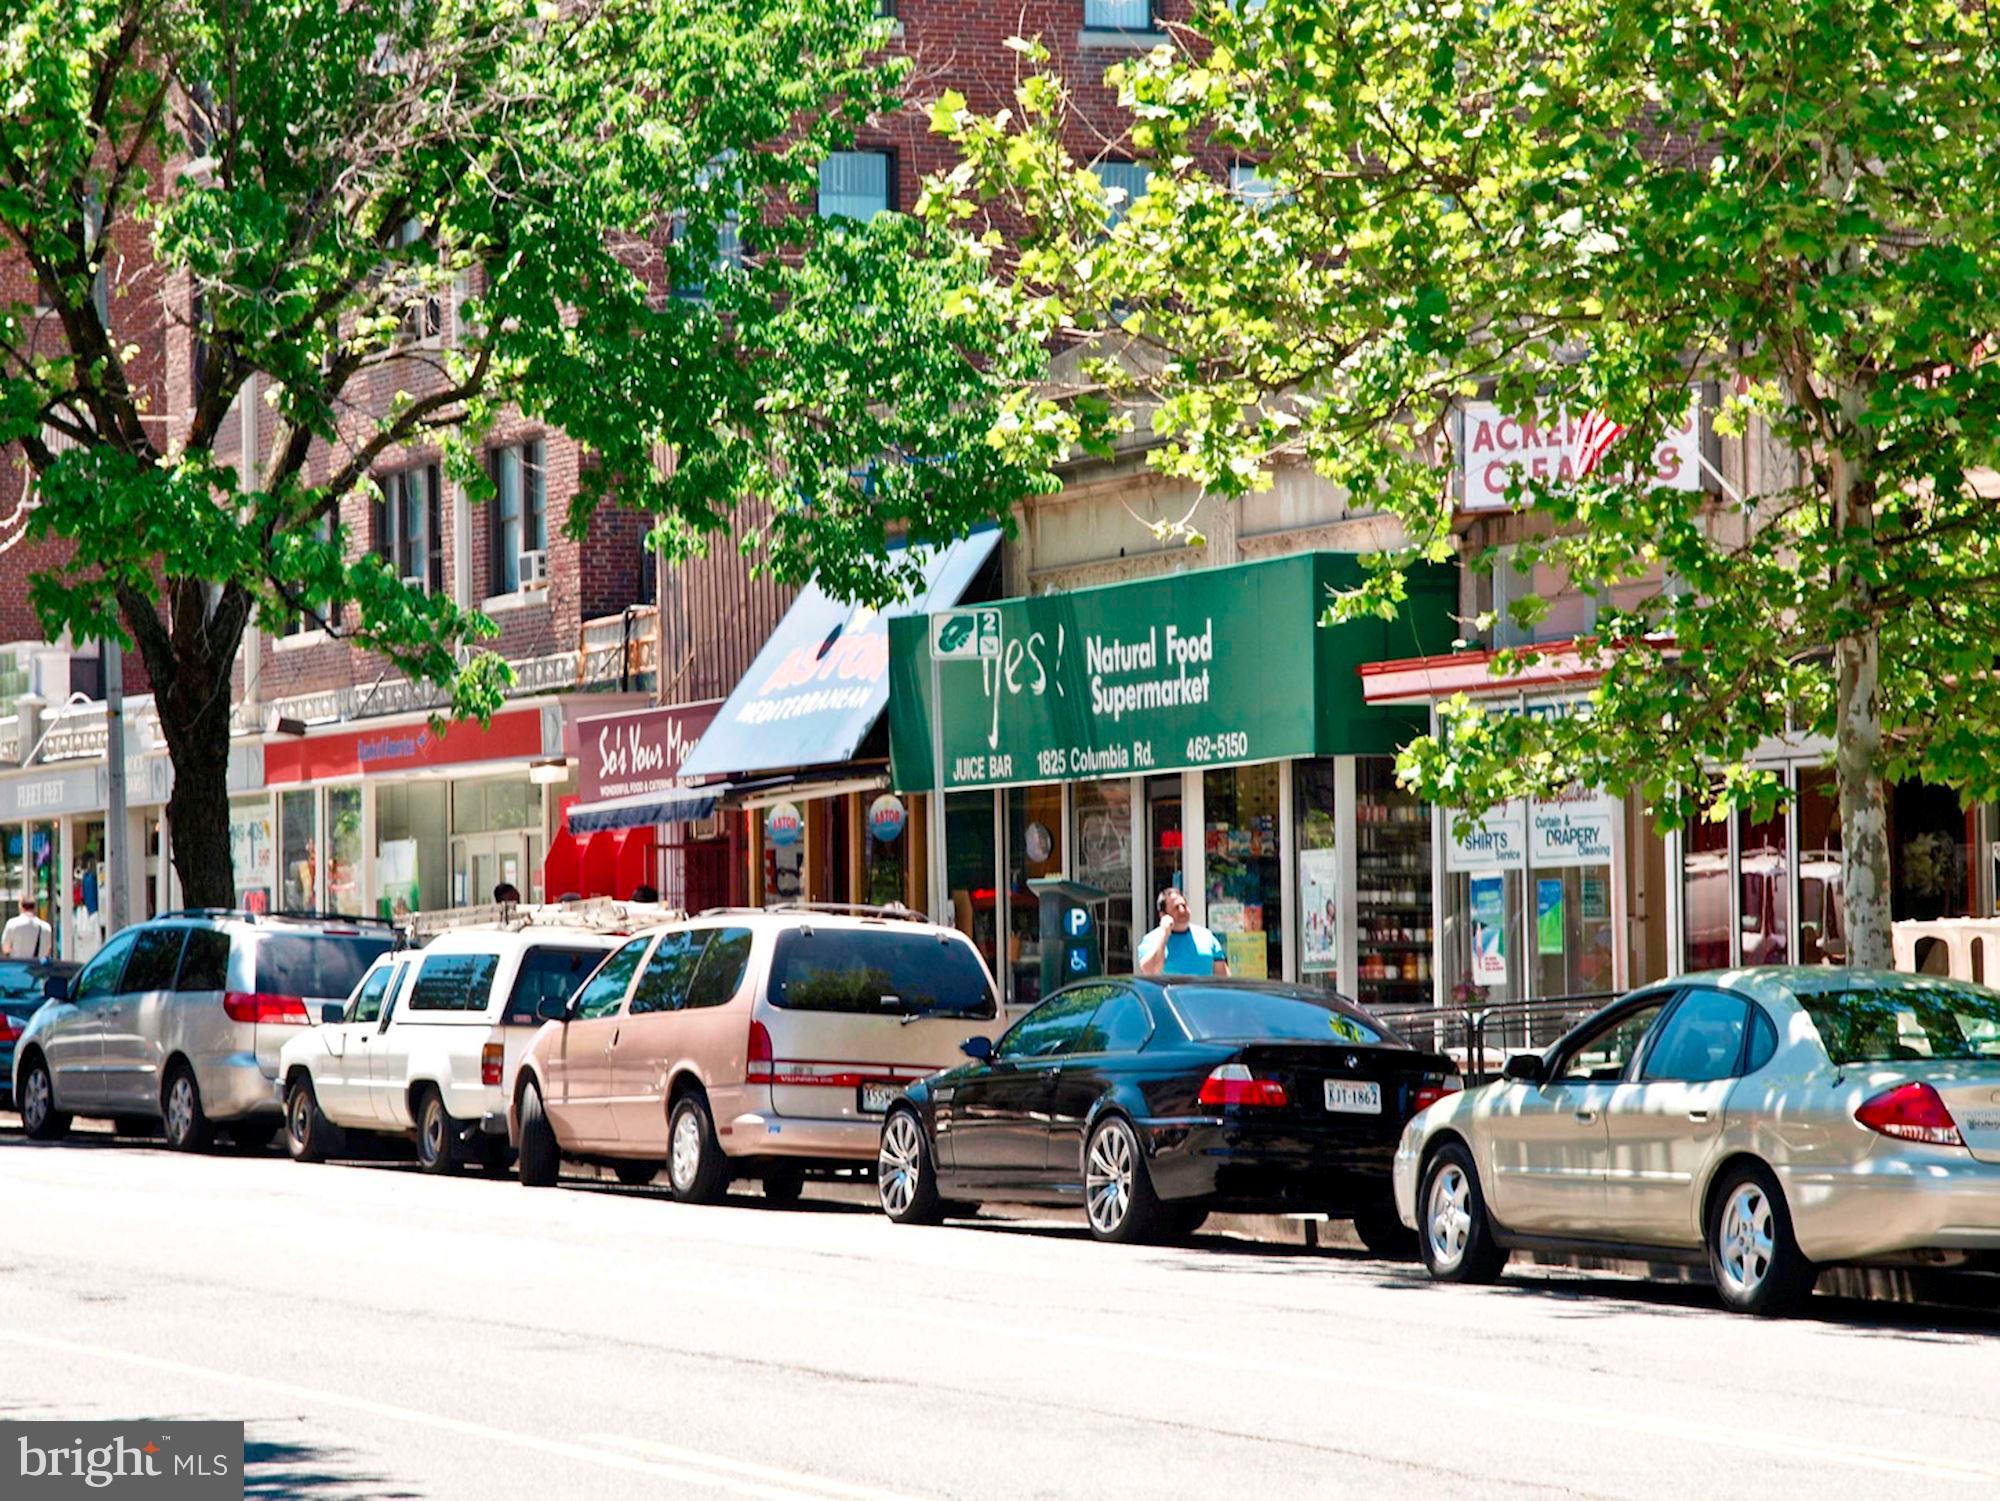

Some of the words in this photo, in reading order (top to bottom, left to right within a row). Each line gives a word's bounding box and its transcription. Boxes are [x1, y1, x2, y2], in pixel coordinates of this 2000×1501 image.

[983, 613, 996, 631] 2
[1086, 626, 1156, 675] Natural
[1166, 617, 1213, 665] Food
[1092, 664, 1210, 722] Supermarket
[735, 687, 873, 725] MEDITERRANEAN
[599, 725, 627, 779] So's
[629, 722, 663, 774] Your
[953, 757, 985, 781] JUICE
[989, 754, 1012, 779] BAR
[1037, 749, 1066, 775] 1825
[1070, 743, 1129, 772] Columbia
[1133, 740, 1155, 766] Rd.
[1186, 731, 1248, 761] 462-5150
[773, 816, 797, 831] ASTOR
[875, 809, 900, 824] ASTOR
[1465, 831, 1508, 851] SHIRTS
[1546, 825, 1600, 847] DRAPERY
[1495, 850, 1521, 861] Service
[1577, 844, 1610, 858] Cleaning
[1071, 908, 1087, 935] P
